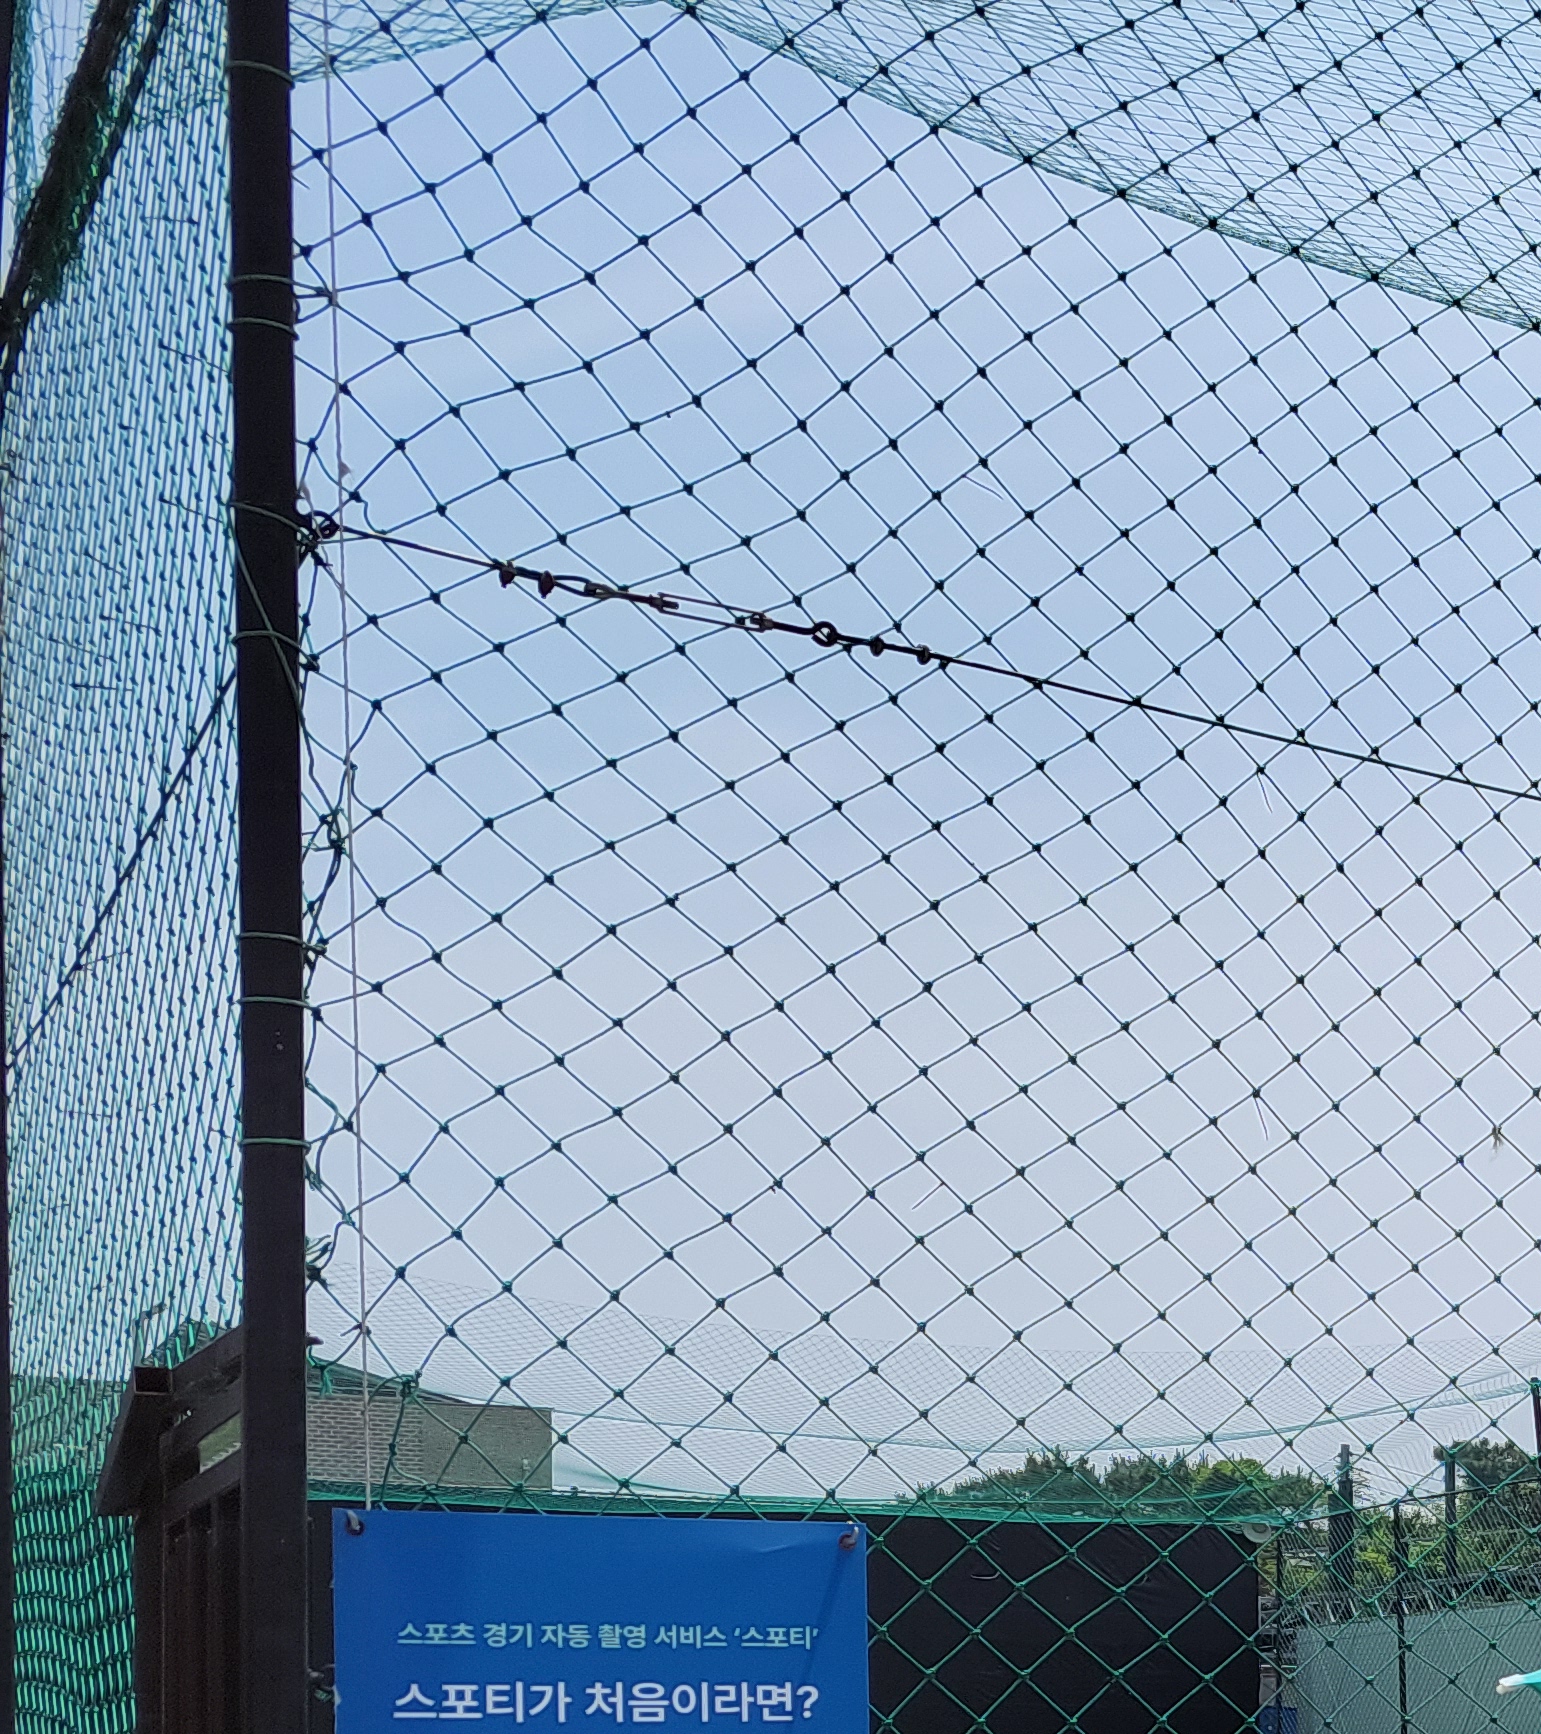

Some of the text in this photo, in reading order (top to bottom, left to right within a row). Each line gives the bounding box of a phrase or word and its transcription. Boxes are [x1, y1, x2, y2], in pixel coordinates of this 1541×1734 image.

[396, 1621, 477, 1646] 스포츠
[482, 1621, 534, 1649] 경기
[540, 1622, 593, 1649] 자동
[597, 1623, 647, 1650] 촬영
[653, 1623, 729, 1650] 서비스
[392, 1680, 820, 1724] 스포티가 처음이라면?
